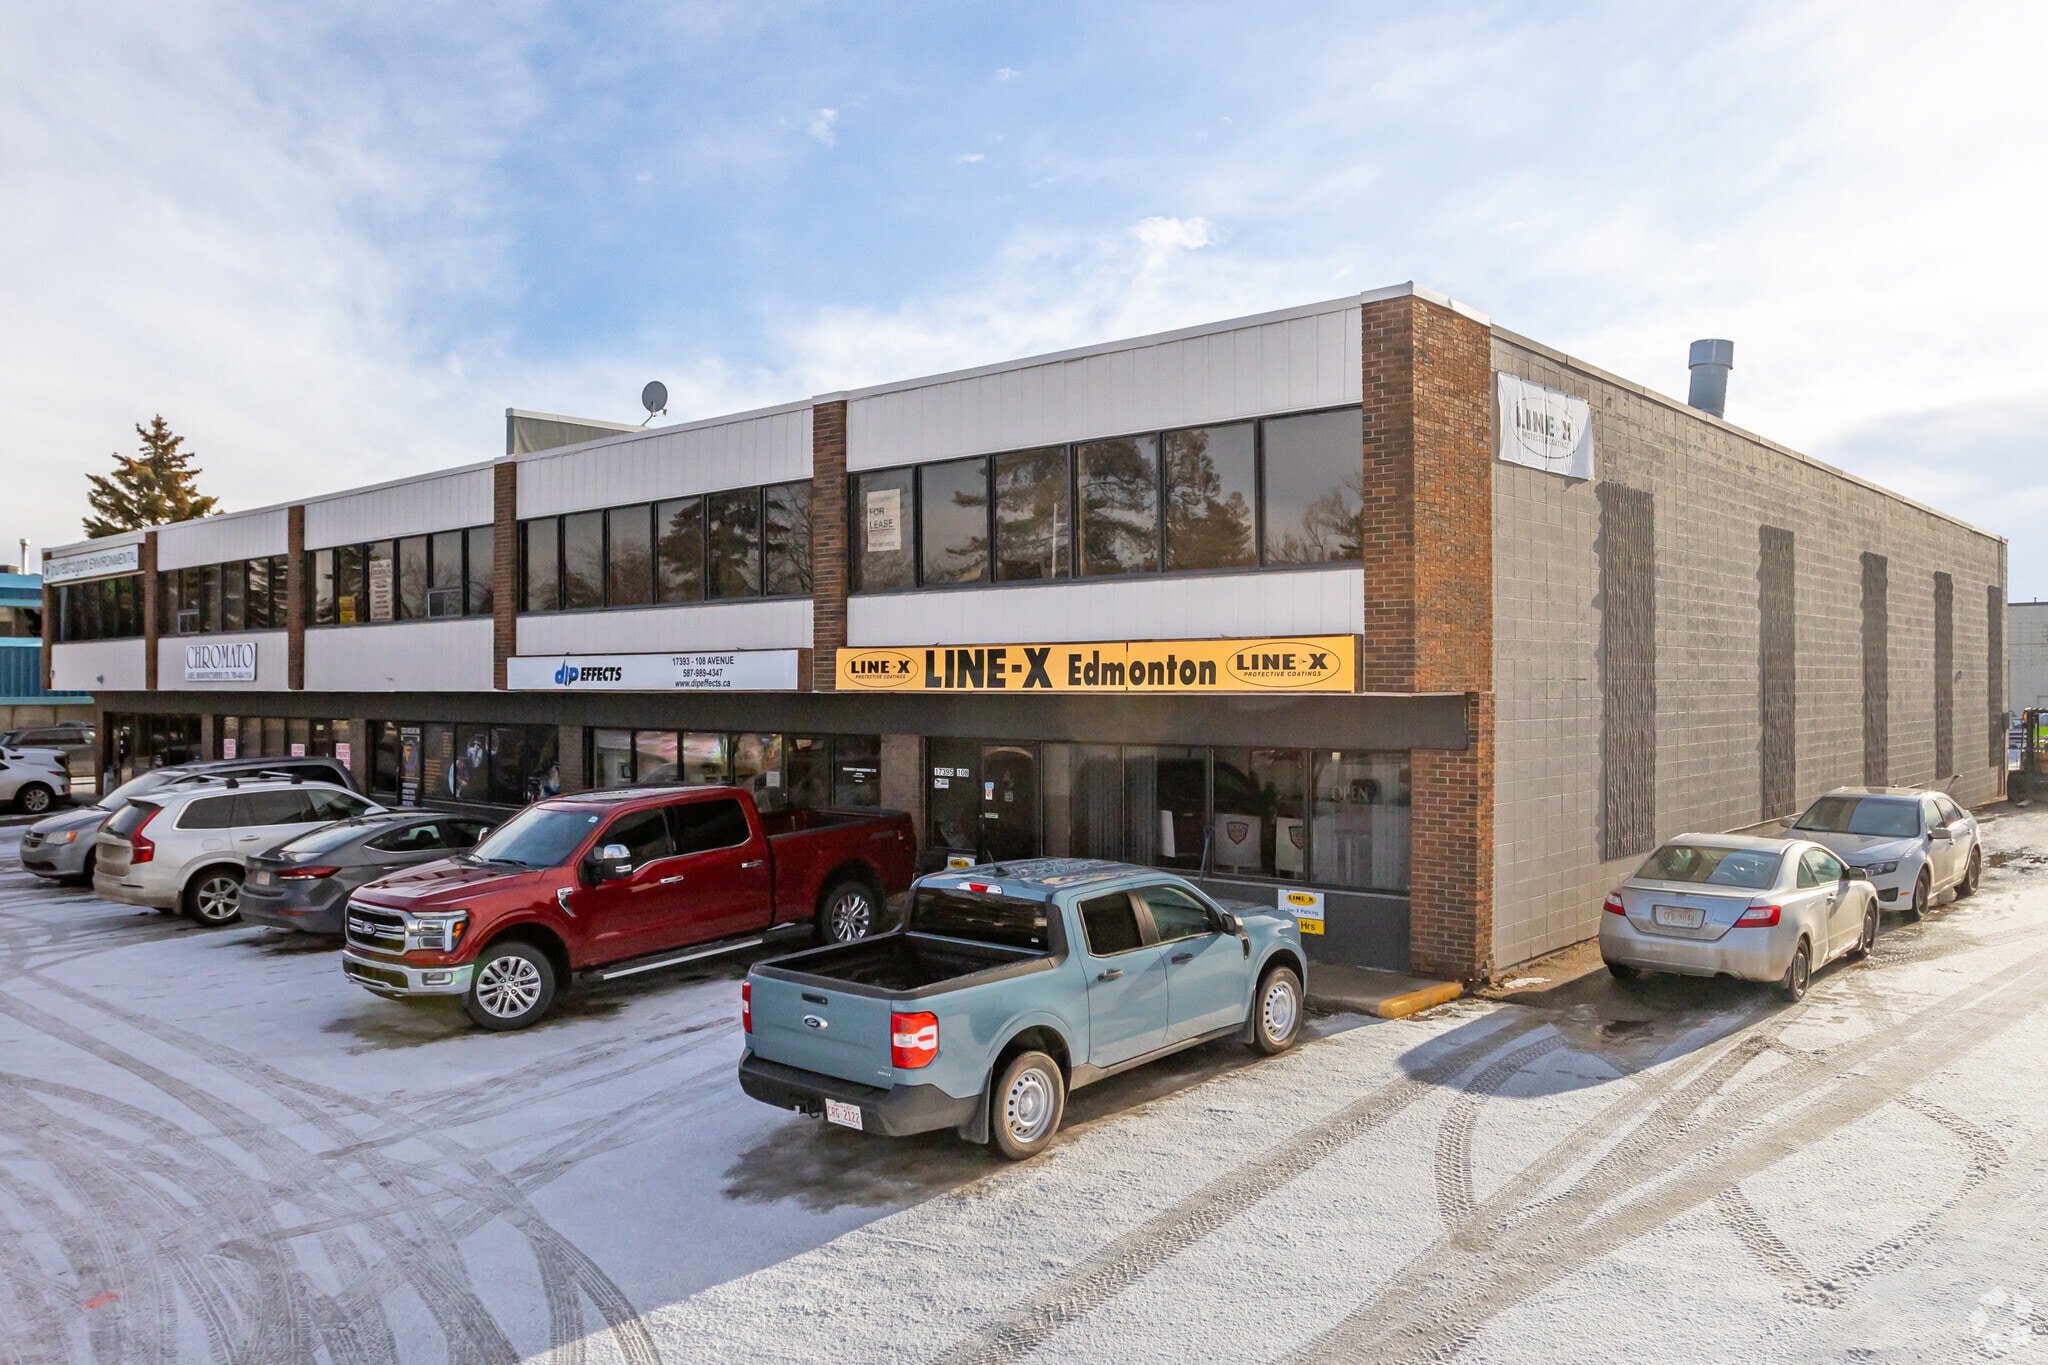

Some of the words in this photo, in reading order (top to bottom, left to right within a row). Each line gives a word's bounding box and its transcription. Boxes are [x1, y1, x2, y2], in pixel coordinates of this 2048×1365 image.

[869, 507, 885, 517] FOR
[869, 519, 893, 530] LEASE
[186, 644, 253, 669] CHROMATO
[672, 657, 690, 666] 17393
[695, 657, 706, 665] 108
[707, 656, 734, 666] AVENUE
[683, 668, 723, 678] 587-989-4347
[925, 647, 1053, 689] LINE-X
[1068, 650, 1217, 686] Edmonton
[580, 666, 622, 682] EFFECTS
[675, 679, 731, 688] www.dipeffects.ca
[935, 768, 953, 776] 17395
[957, 769, 969, 777] 108
[1331, 785, 1370, 801] OPEN
[1300, 908, 1319, 917] Parking
[1300, 920, 1316, 931] Hrs
